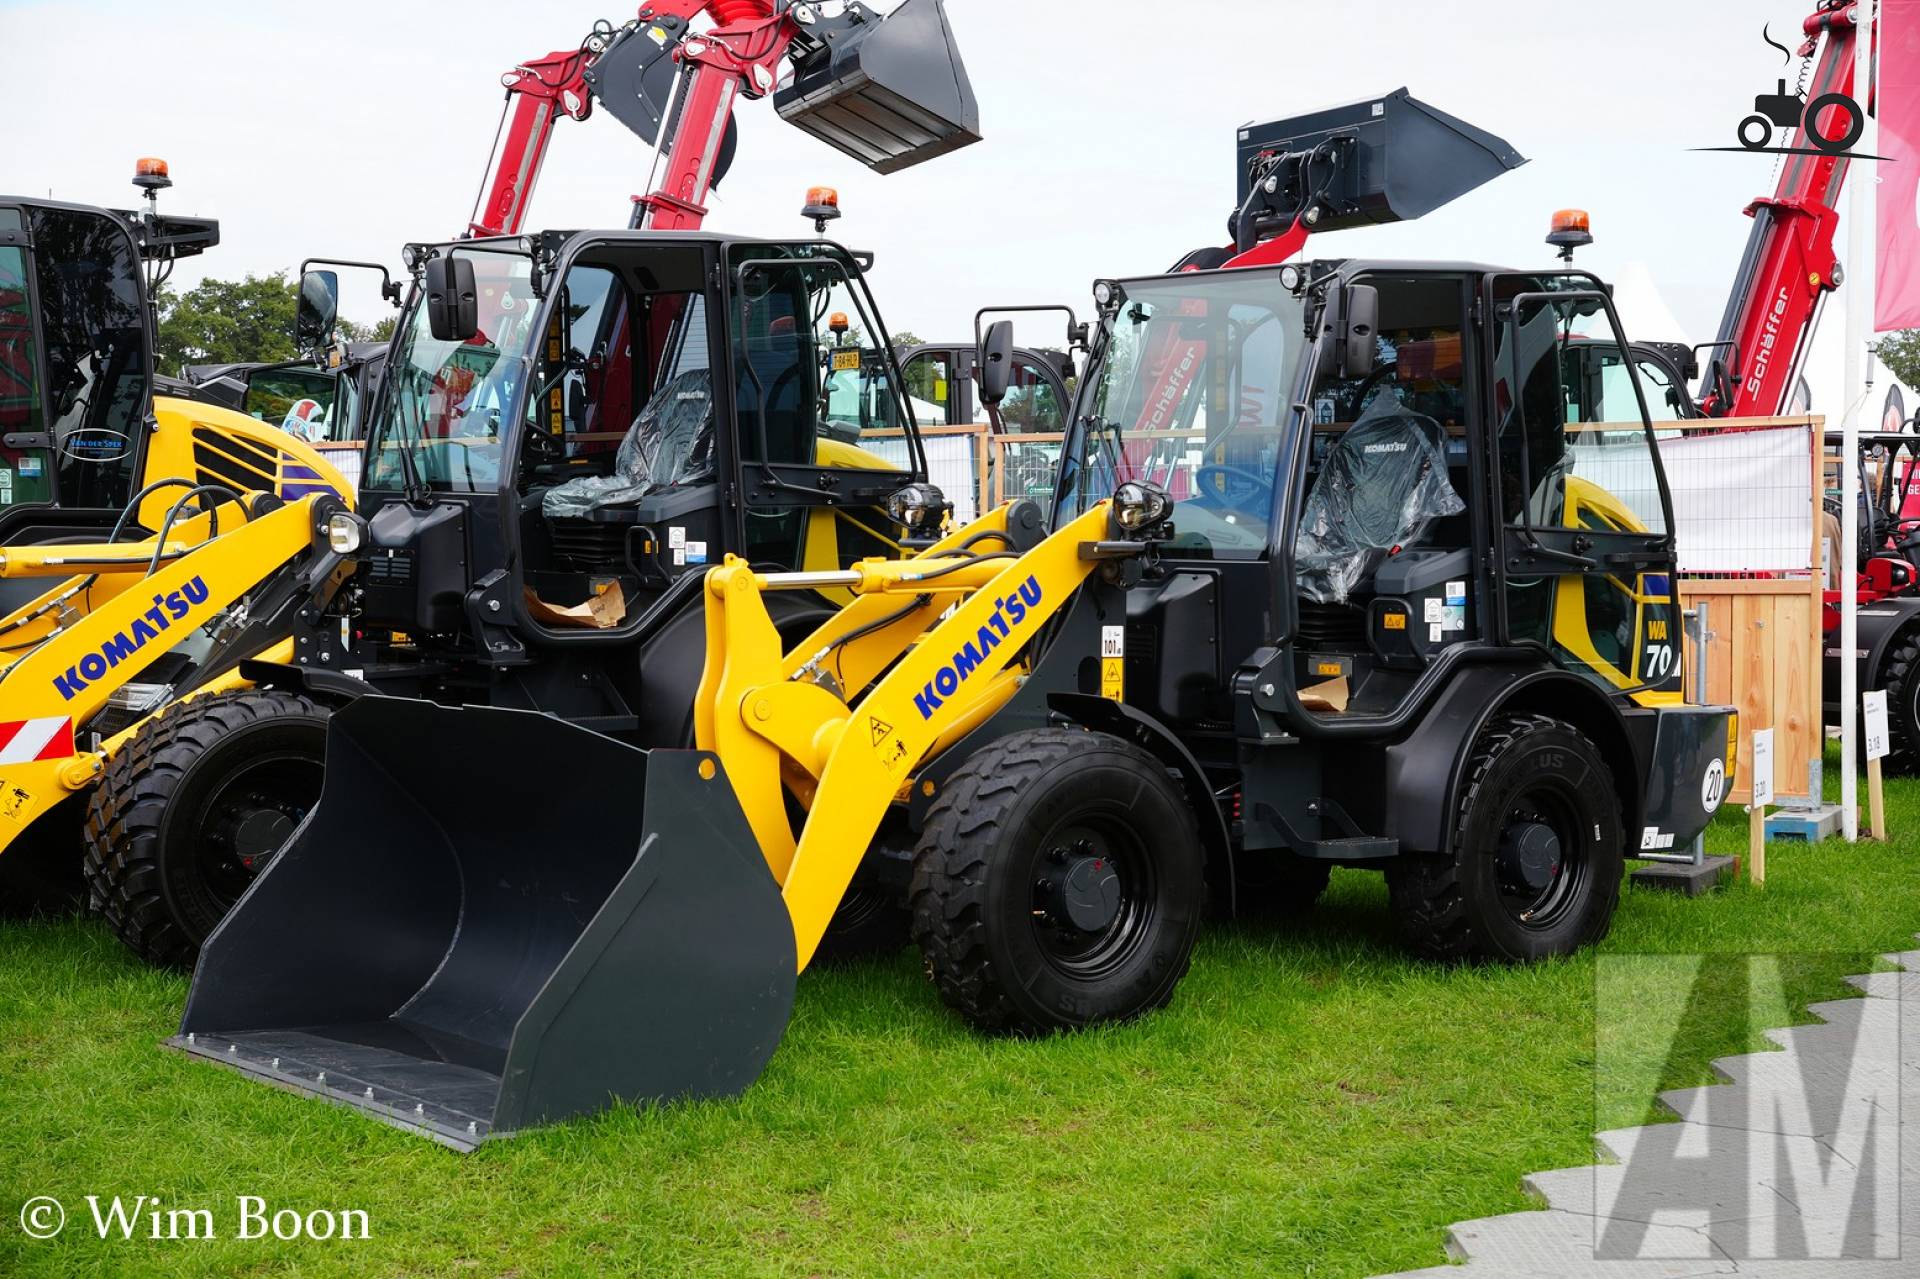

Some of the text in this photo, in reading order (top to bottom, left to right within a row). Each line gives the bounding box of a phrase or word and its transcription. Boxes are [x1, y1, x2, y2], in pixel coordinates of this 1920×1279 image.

[1746, 286, 1788, 401] Schäffer
[1364, 441, 1408, 454] KOMATSU
[52, 575, 209, 701] KOMATSU
[1104, 639, 1117, 654] 101
[1648, 620, 1668, 640] WA
[912, 574, 1042, 721] KOMATSU
[1705, 769, 1722, 802] 20
